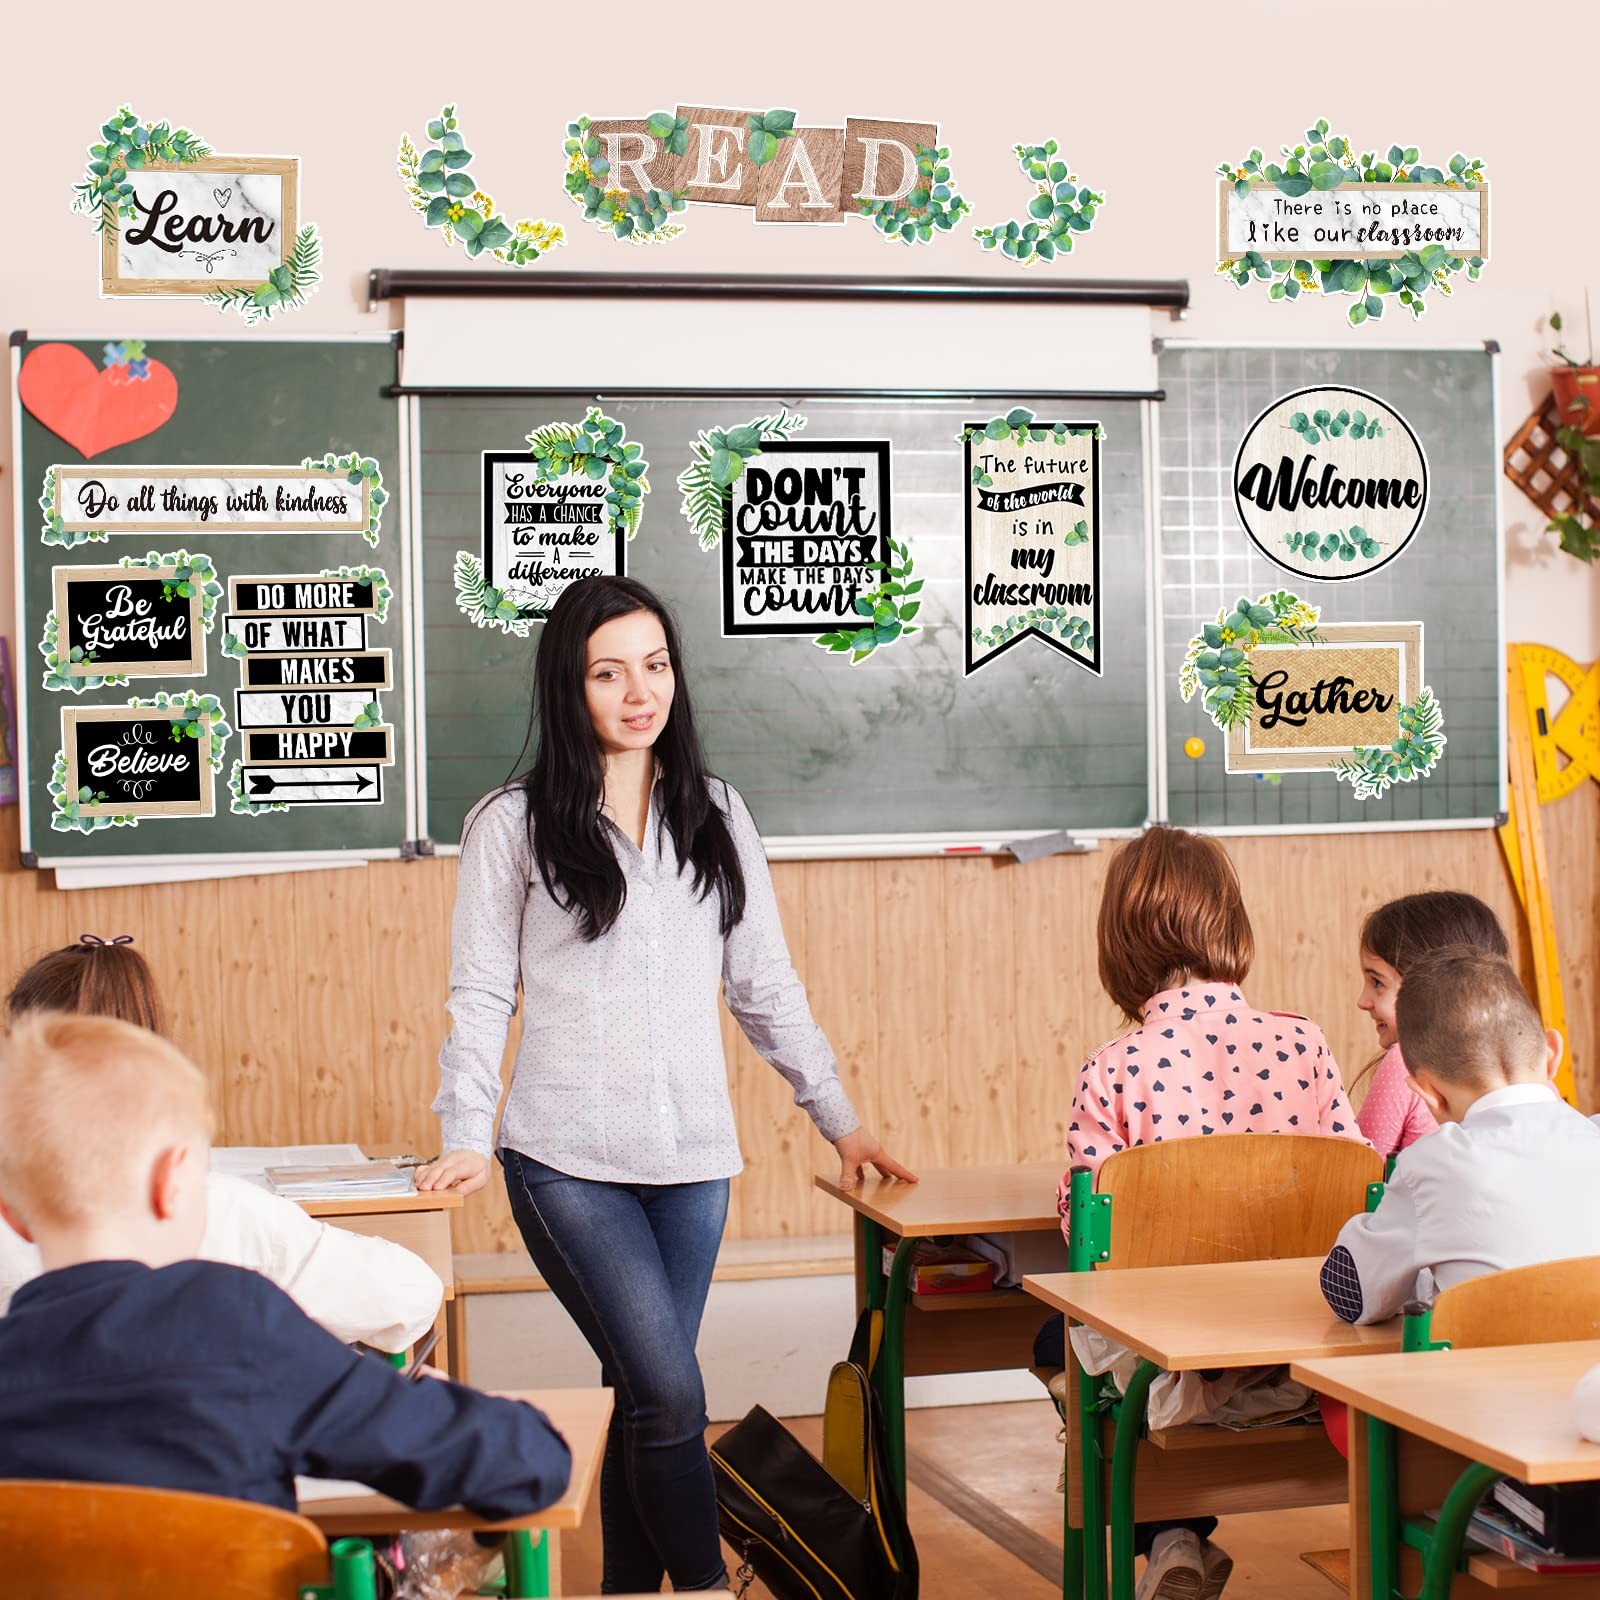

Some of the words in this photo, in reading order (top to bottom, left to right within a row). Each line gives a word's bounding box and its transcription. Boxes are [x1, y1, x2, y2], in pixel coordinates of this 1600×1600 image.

[599, 123, 919, 208] READ
[126, 189, 275, 253] Learn
[1274, 198, 1323, 216] There
[1335, 200, 1351, 215] is
[1362, 202, 1382, 215] no
[1391, 199, 1438, 217] place
[1247, 220, 1299, 243] like
[1314, 226, 1351, 242] our
[1356, 220, 1464, 246] classroom
[980, 454, 1017, 474] The
[1024, 456, 1088, 475] future
[505, 473, 607, 505] Everyone
[746, 467, 866, 506] DON'T
[987, 494, 1001, 511] of
[1003, 493, 1027, 511] the
[1028, 483, 1076, 505] world
[1238, 454, 1423, 512] Welcome
[78, 480, 119, 519] Do
[127, 485, 155, 512] all
[160, 485, 218, 521] things
[226, 485, 268, 512] with
[275, 485, 348, 512] kindness
[511, 505, 533, 523] HAS
[539, 505, 547, 522] A
[553, 504, 599, 523] CHANCE
[736, 493, 876, 536] count
[512, 526, 536, 546] to
[538, 525, 600, 546] make
[1012, 519, 1028, 536] is
[1036, 520, 1054, 535] in
[553, 547, 561, 564] A
[751, 540, 794, 564] THE
[1010, 548, 1056, 578] my
[508, 561, 604, 587] difference
[740, 568, 786, 585] MAKE
[794, 568, 825, 584] THE
[833, 567, 874, 584] DAYS
[105, 585, 152, 619] Be
[256, 584, 285, 610] DO
[295, 583, 355, 609] MORE
[744, 577, 863, 616] count
[973, 573, 1093, 607] classroom
[77, 614, 187, 650] Grateful
[244, 622, 272, 648] OF
[282, 620, 347, 647] WHAT
[280, 658, 355, 684] MAKES
[280, 694, 331, 723] YOU
[1247, 670, 1394, 729] Gather
[278, 732, 353, 758] HAPPY
[87, 744, 190, 777] Believe
